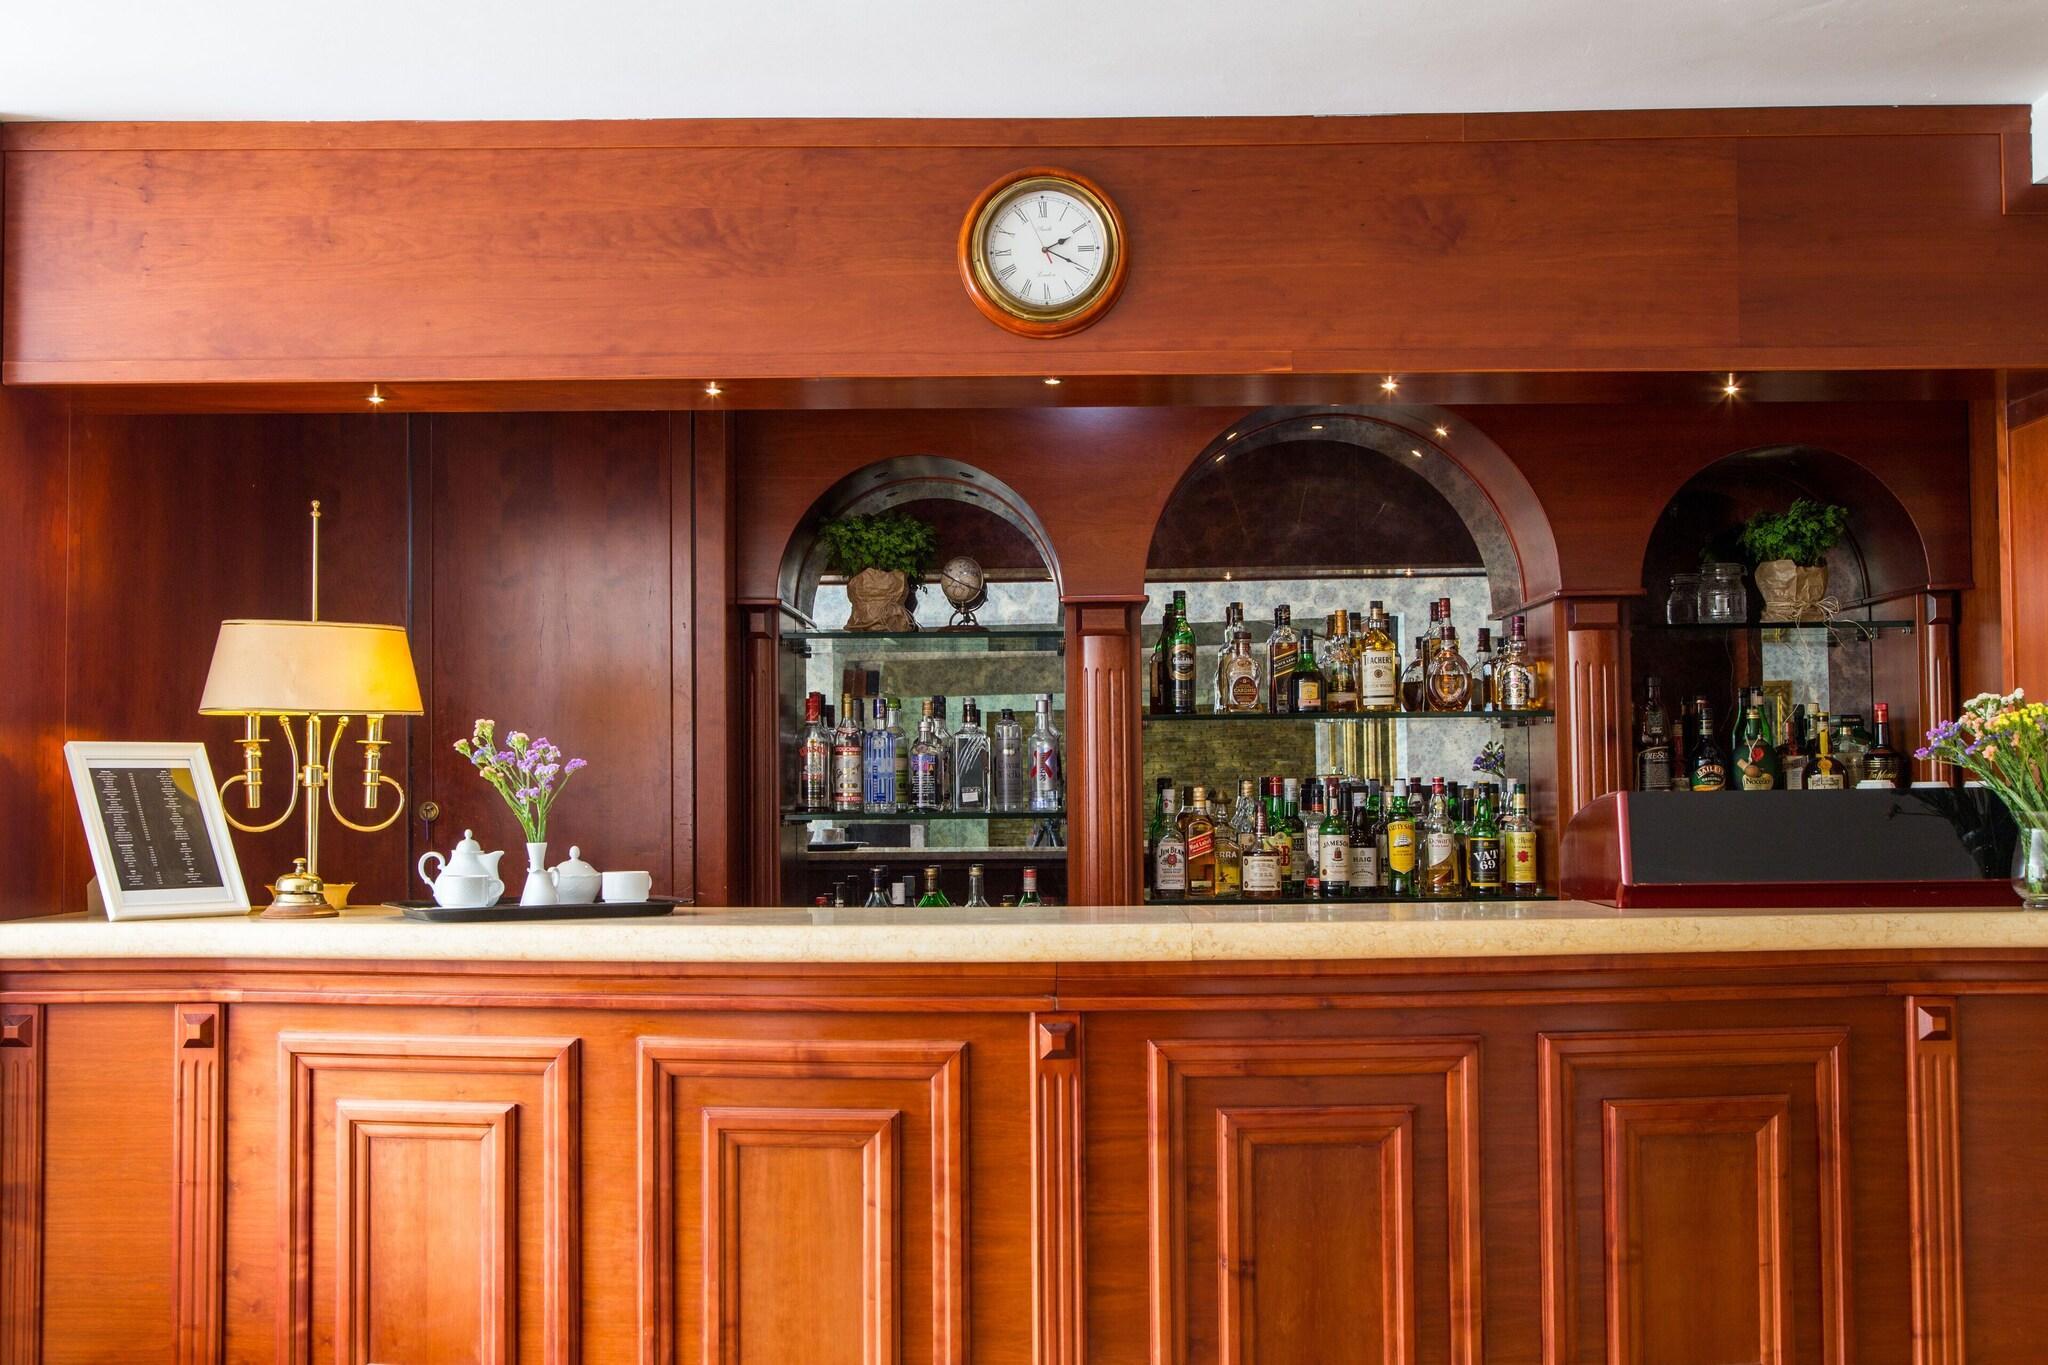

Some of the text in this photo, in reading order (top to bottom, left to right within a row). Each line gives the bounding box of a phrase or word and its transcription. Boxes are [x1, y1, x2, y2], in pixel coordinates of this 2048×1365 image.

[1322, 839, 1349, 849] JAMESO
[1472, 849, 1499, 862] VAT
[1479, 859, 1496, 870] 69
